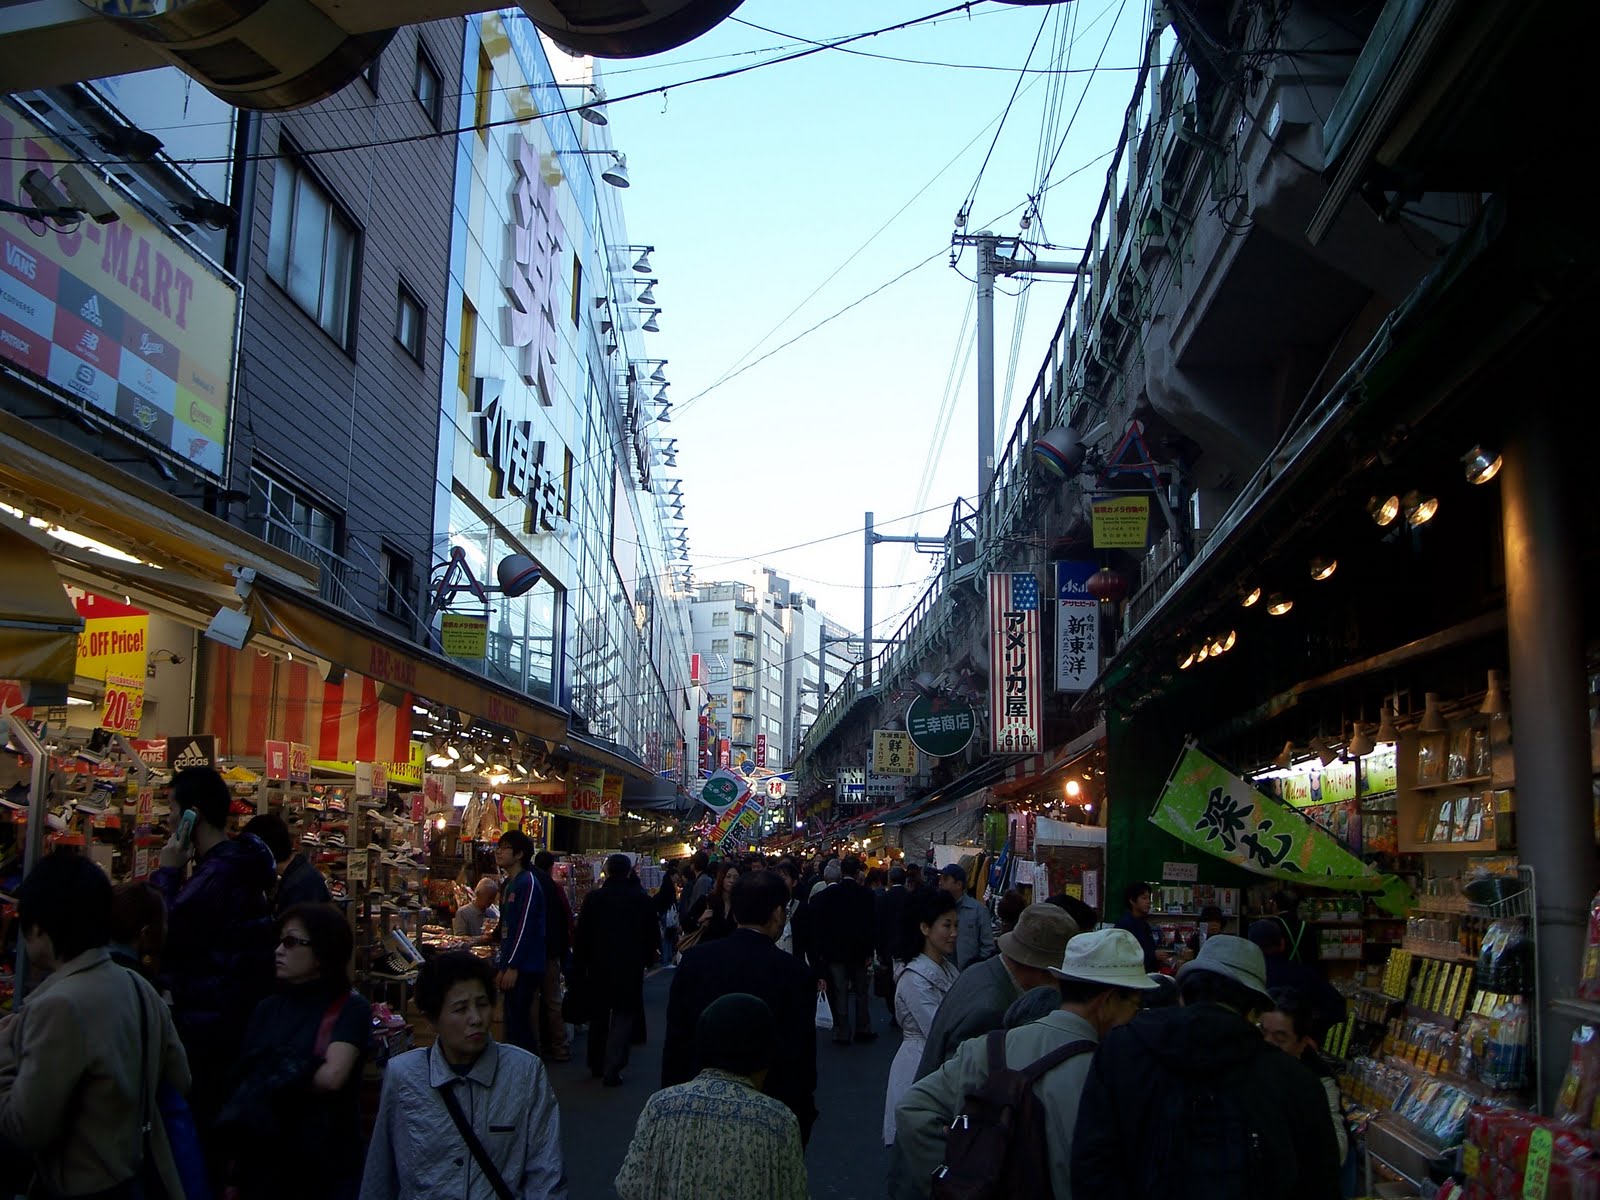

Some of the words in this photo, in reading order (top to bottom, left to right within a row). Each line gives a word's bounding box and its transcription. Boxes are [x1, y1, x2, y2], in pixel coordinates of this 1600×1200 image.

[6, 240, 37, 281] VANS
[1061, 579, 1089, 594] Asa
[1062, 600, 1096, 608] アサヒビール
[90, 631, 109, 657] OFF
[111, 628, 144, 655] Price!
[1003, 611, 1029, 718] アメリカ屋
[102, 689, 127, 729] 20
[912, 712, 970, 736] 三幸商店
[757, 738, 766, 767] カラオケ
[888, 739, 903, 767] 鮮魚
[1005, 734, 1029, 746] 610
[174, 756, 209, 768] adidas
[769, 782, 782, 795] 横
